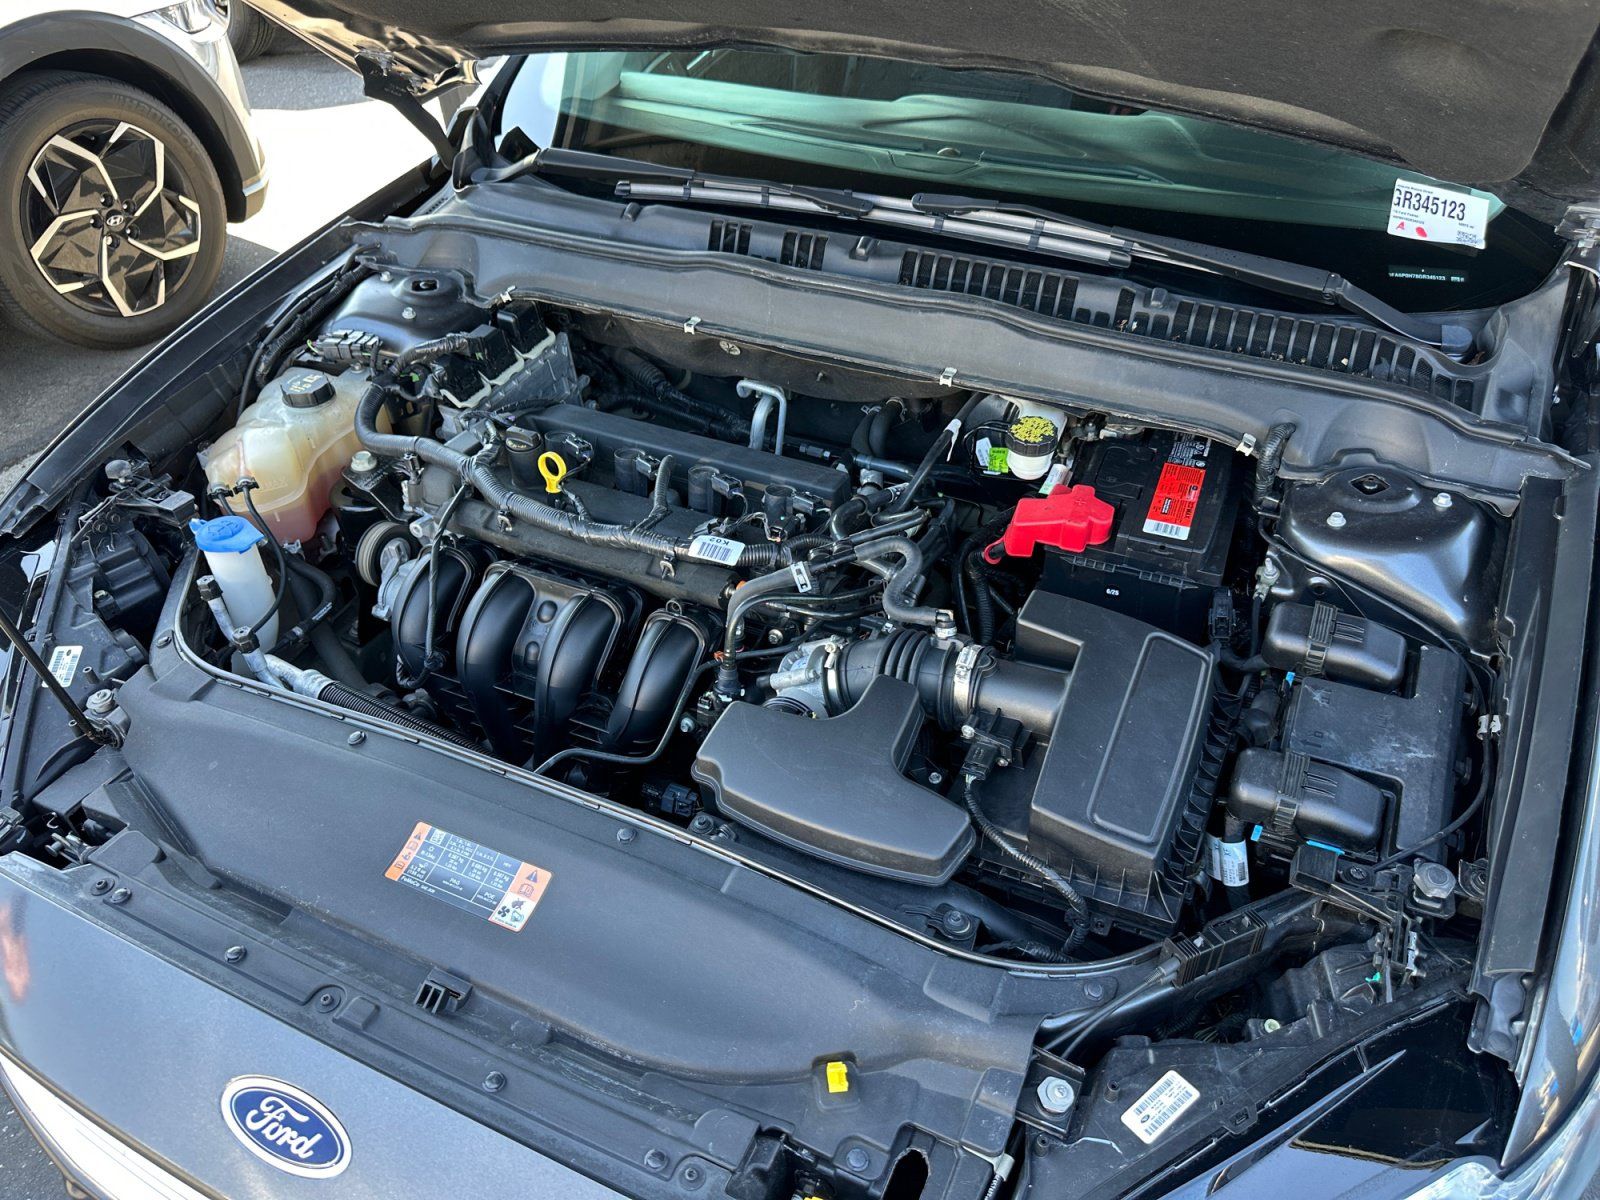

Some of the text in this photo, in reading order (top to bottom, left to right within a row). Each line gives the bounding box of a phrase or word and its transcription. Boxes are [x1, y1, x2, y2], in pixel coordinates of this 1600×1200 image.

[709, 537, 731, 546] K02
[401, 875, 421, 887] FoMoCo
[245, 1095, 323, 1159] Ford
